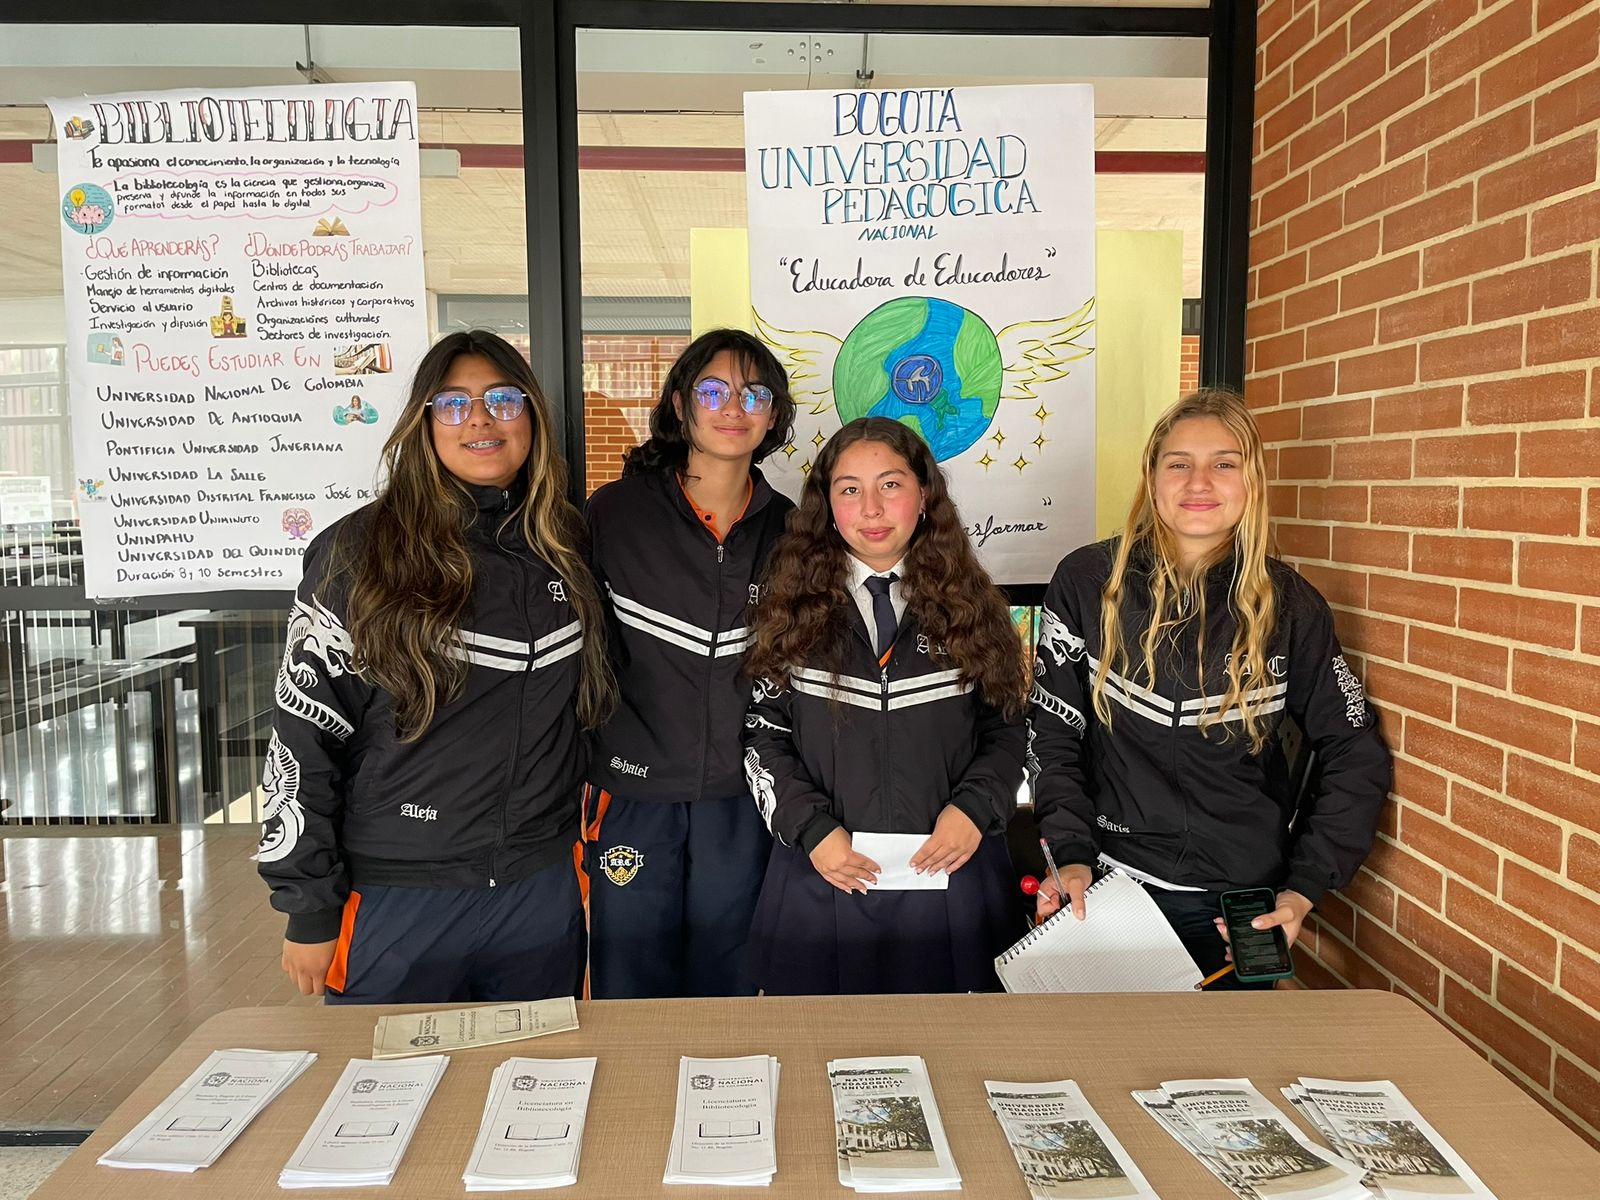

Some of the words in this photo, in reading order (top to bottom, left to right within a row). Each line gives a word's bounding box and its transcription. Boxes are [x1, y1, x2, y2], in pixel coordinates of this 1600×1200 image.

[832, 88, 963, 136] BOGOTÁ
[87, 145, 103, 168] Te
[107, 156, 160, 172] apasiona
[166, 156, 177, 167] el
[250, 155, 260, 166] la
[262, 157, 325, 169] organización
[327, 159, 334, 167] y
[337, 155, 345, 165] la
[348, 155, 400, 169] tecnología
[758, 135, 1027, 189] UNIVERSIDAD
[114, 180, 129, 192] La
[215, 180, 227, 189] es
[231, 177, 241, 188] la
[243, 179, 276, 187] ciencia
[282, 178, 297, 189] que
[117, 192, 152, 205] preserva
[159, 193, 164, 201] y
[170, 189, 201, 200] difunde
[208, 188, 216, 198] la
[224, 190, 280, 199] información
[286, 190, 297, 198] en
[301, 188, 326, 197] todos
[124, 201, 165, 214] formatos
[171, 199, 193, 209] desde
[201, 199, 209, 208] el
[213, 200, 235, 211] papel
[242, 199, 267, 208] hasta
[857, 224, 938, 241] NACIONAL
[349, 235, 414, 256] TRABAJAR?
[137, 264, 152, 280] de
[158, 268, 229, 281] información
[251, 258, 319, 278] Bibliotecas
[903, 257, 925, 287] de
[86, 283, 122, 299] Manejo
[127, 285, 137, 295] de
[140, 284, 194, 295] herramientas
[198, 283, 235, 296] digitales
[253, 280, 288, 291] Centros
[292, 281, 303, 291] de
[309, 279, 383, 290] documentación
[89, 298, 136, 314] Servicio
[142, 301, 152, 312] al
[155, 302, 193, 312] usuario
[257, 296, 298, 308] Archivos
[301, 297, 345, 307] históricos
[350, 299, 355, 308] y
[356, 297, 415, 308] corporativos
[89, 316, 155, 333] Investigación
[161, 321, 168, 332] y
[170, 316, 208, 328] difusión
[336, 312, 380, 324] culturales
[257, 327, 304, 340] Sectores
[308, 327, 321, 339] de
[132, 343, 200, 377] PUEDES
[208, 345, 285, 371] ESTUDIAR
[294, 346, 321, 368] EN
[97, 385, 195, 404] UNIVERSIDAD
[205, 384, 265, 402] NACIONAL
[101, 411, 195, 430] UNIVERSIDAD
[231, 412, 302, 425] ANTIOQUIA
[106, 439, 175, 456] PONTIFICIA
[182, 440, 259, 454] UNIVERSIDAD
[269, 434, 343, 453] JAVERIANA
[108, 467, 198, 482] UNIVERSIDAD
[207, 467, 223, 480] LA
[230, 468, 266, 482] SALLE
[111, 493, 190, 508] UNIVERSIDAD
[197, 490, 254, 503] DISTRITAL
[259, 489, 316, 501] FRANCISCO
[325, 483, 351, 500] JOSÉ
[357, 489, 371, 499] DE
[113, 514, 197, 528] UNIVERSIDAD
[199, 510, 260, 525] UNIMINUTO
[116, 533, 194, 546] UNINPAHU
[118, 549, 214, 562] UNIVERSIDAD
[199, 567, 211, 578] 10
[1096, 814, 1130, 833] Saris
[1182, 1099, 1248, 1107] UNIVERSIDAD
[1314, 1098, 1384, 1106] UNIVERSIDAD
